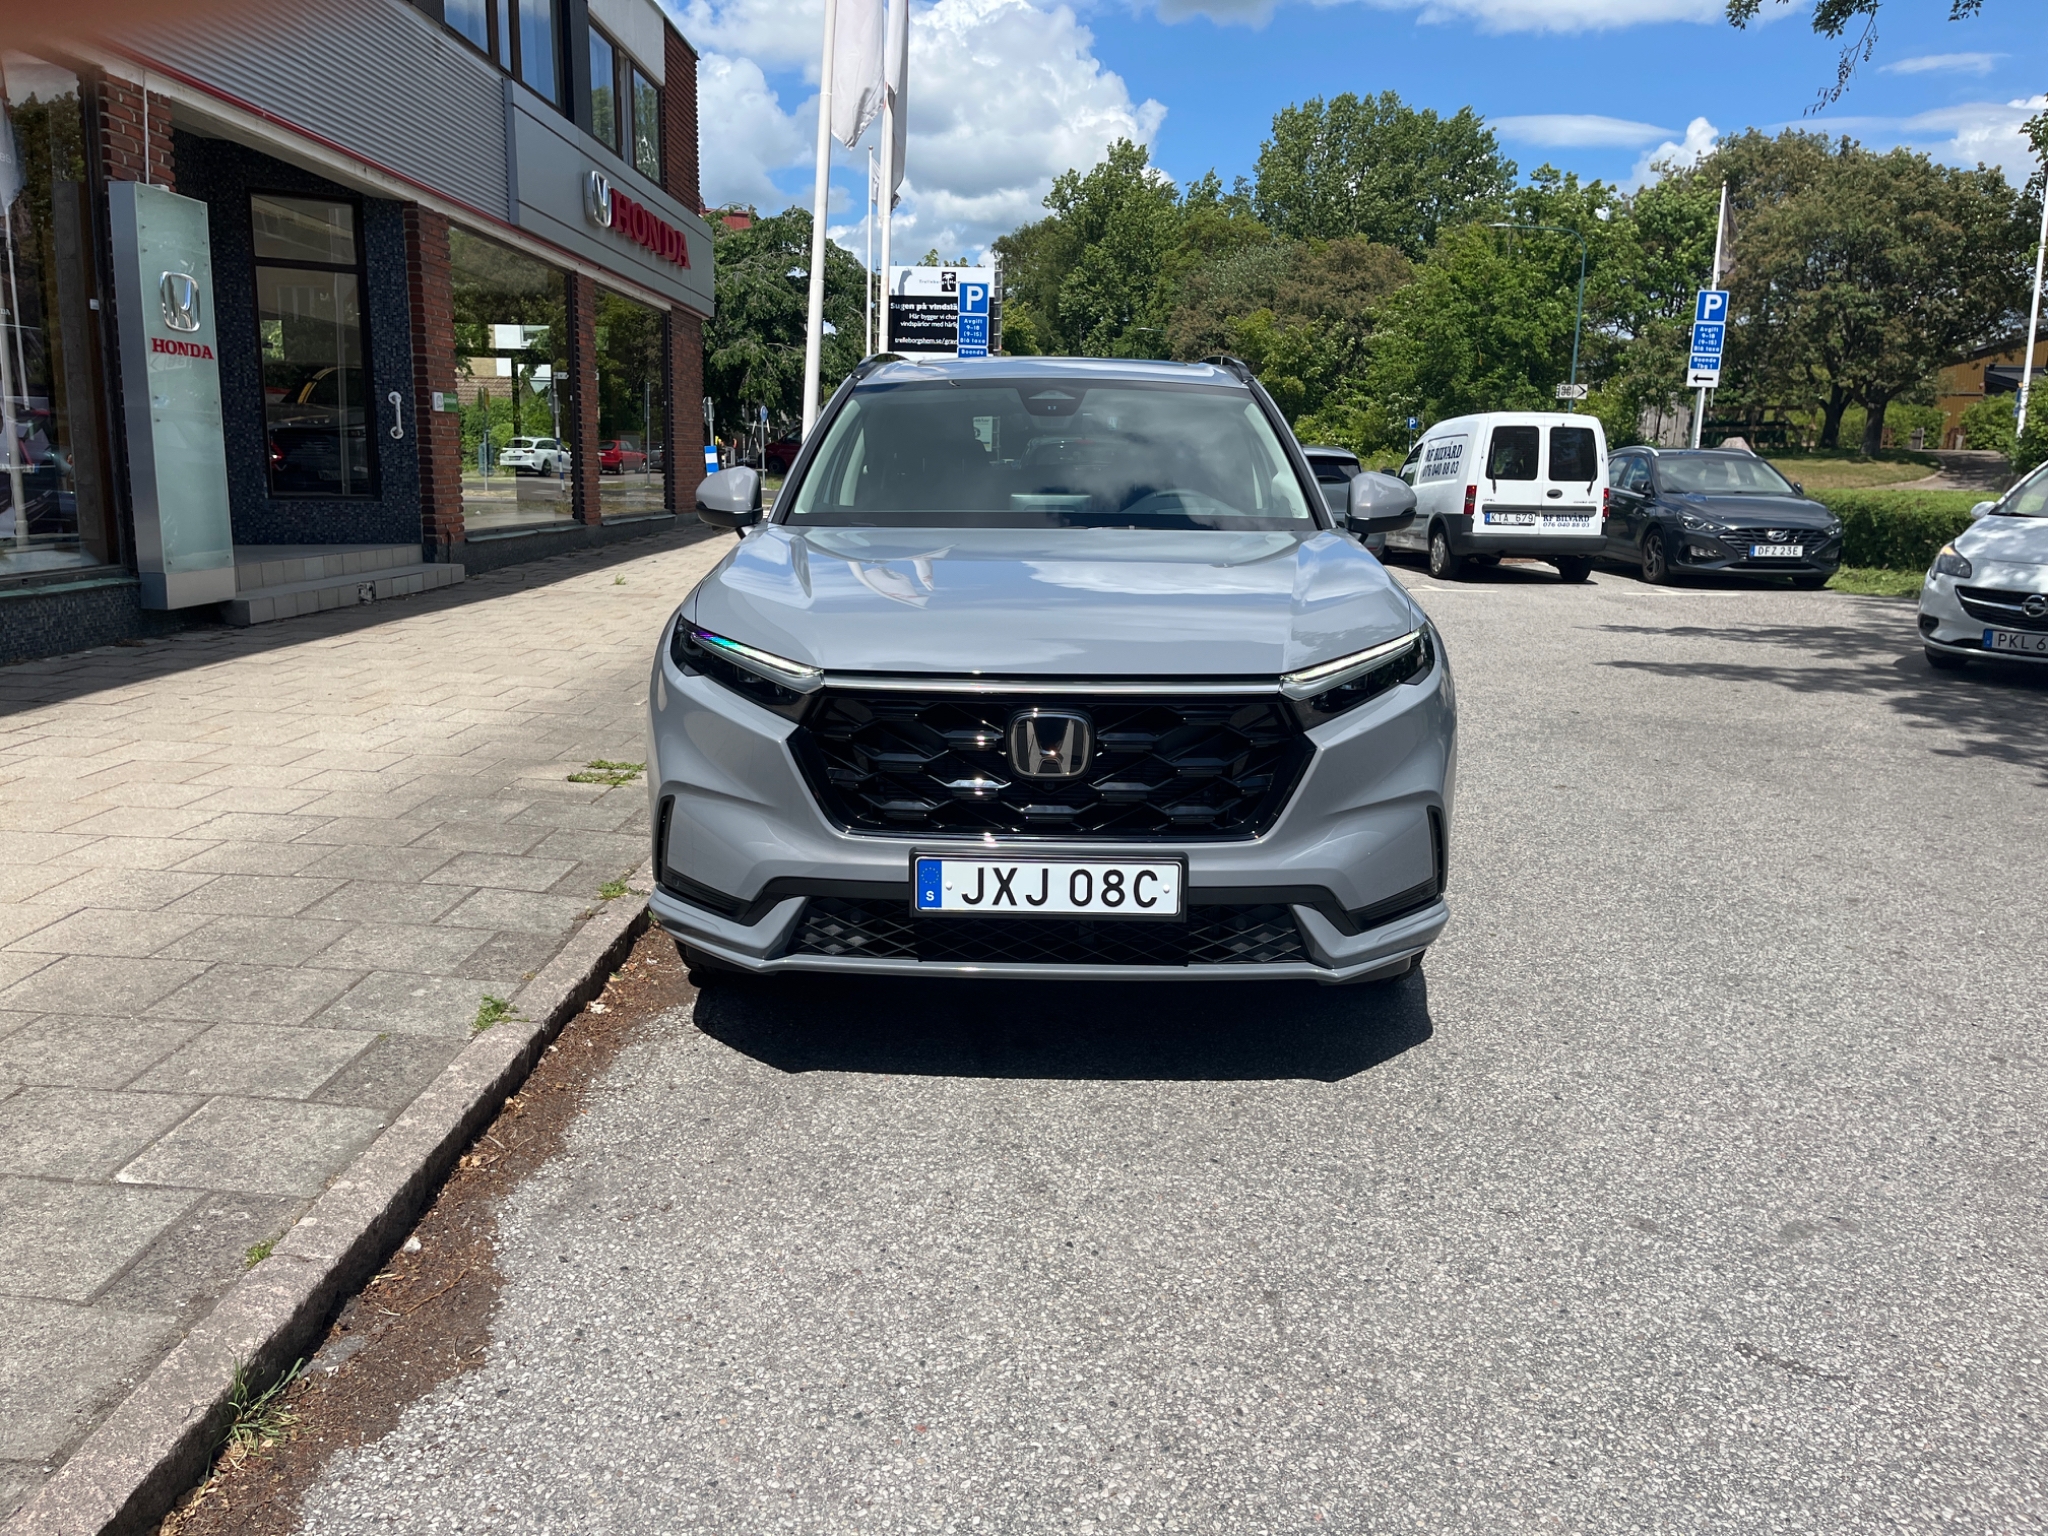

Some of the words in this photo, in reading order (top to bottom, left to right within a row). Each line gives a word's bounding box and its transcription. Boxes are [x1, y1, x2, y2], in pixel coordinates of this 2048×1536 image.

[610, 188, 691, 270] HONDA
[890, 302, 914, 311] Sugen
[916, 302, 927, 311] på
[966, 286, 984, 310] P
[1704, 294, 1722, 319] P
[151, 338, 215, 360] HONDA
[1410, 418, 1416, 428] P
[1425, 449, 1435, 462] RF
[1434, 441, 1462, 461] BILVÅRD
[1422, 464, 1432, 477] 076
[1432, 463, 1442, 476] 040
[1442, 462, 1450, 475] 88
[1450, 460, 1459, 474] 03
[1490, 513, 1508, 521] KTA
[1516, 514, 1533, 522] 679
[1556, 513, 1590, 522] BILVÅRD
[1758, 546, 1777, 555] DFZ
[1780, 547, 1798, 555] 23E
[1998, 634, 2029, 650] PKL
[2036, 638, 2046, 651] 6
[926, 891, 934, 902] S
[961, 866, 1049, 905] JXJ
[1068, 868, 1158, 906] 08C
